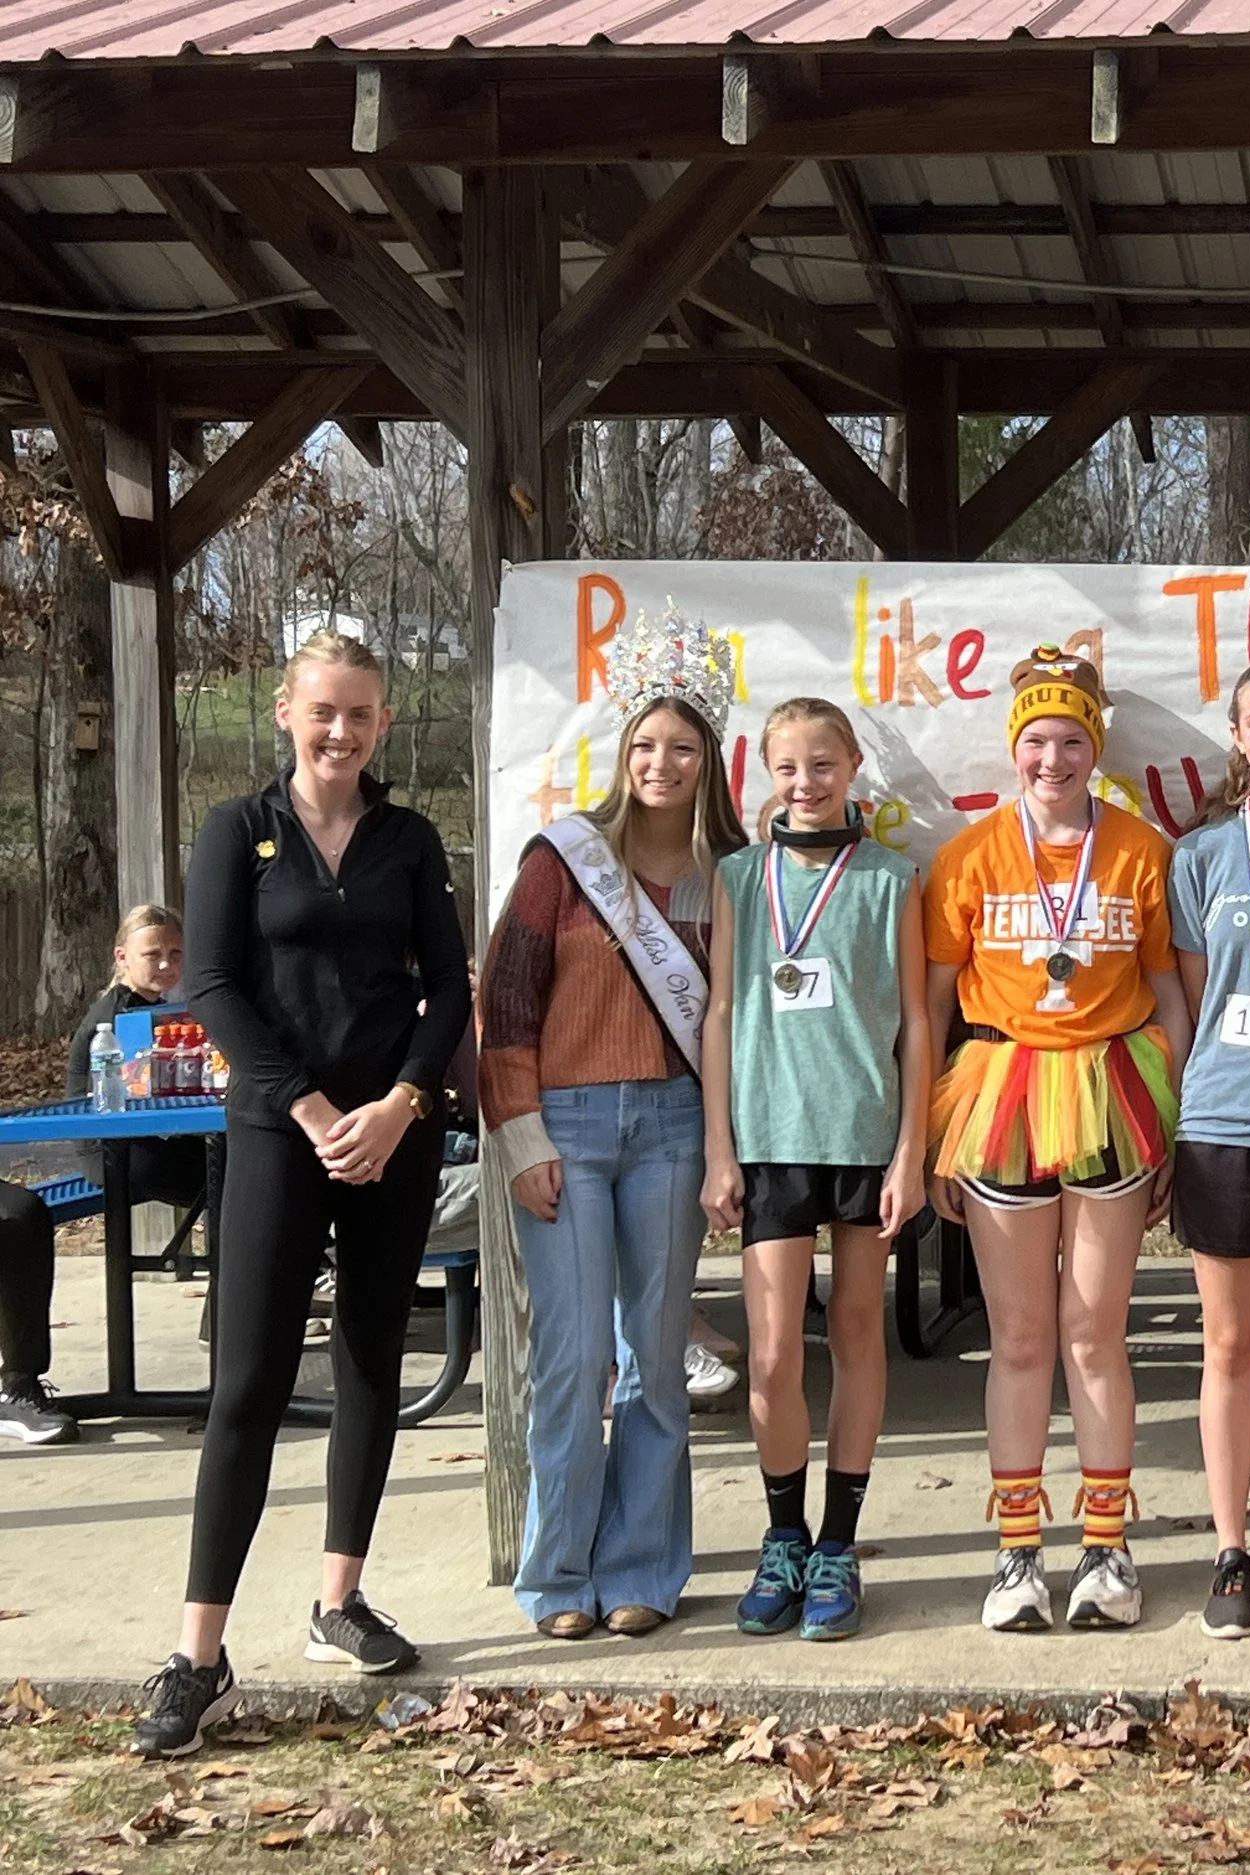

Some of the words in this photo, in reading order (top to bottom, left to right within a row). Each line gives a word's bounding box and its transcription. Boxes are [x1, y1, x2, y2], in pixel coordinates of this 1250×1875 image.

[577, 572, 749, 704] Rn
[852, 575, 992, 709] like
[666, 973, 700, 1021] Van
